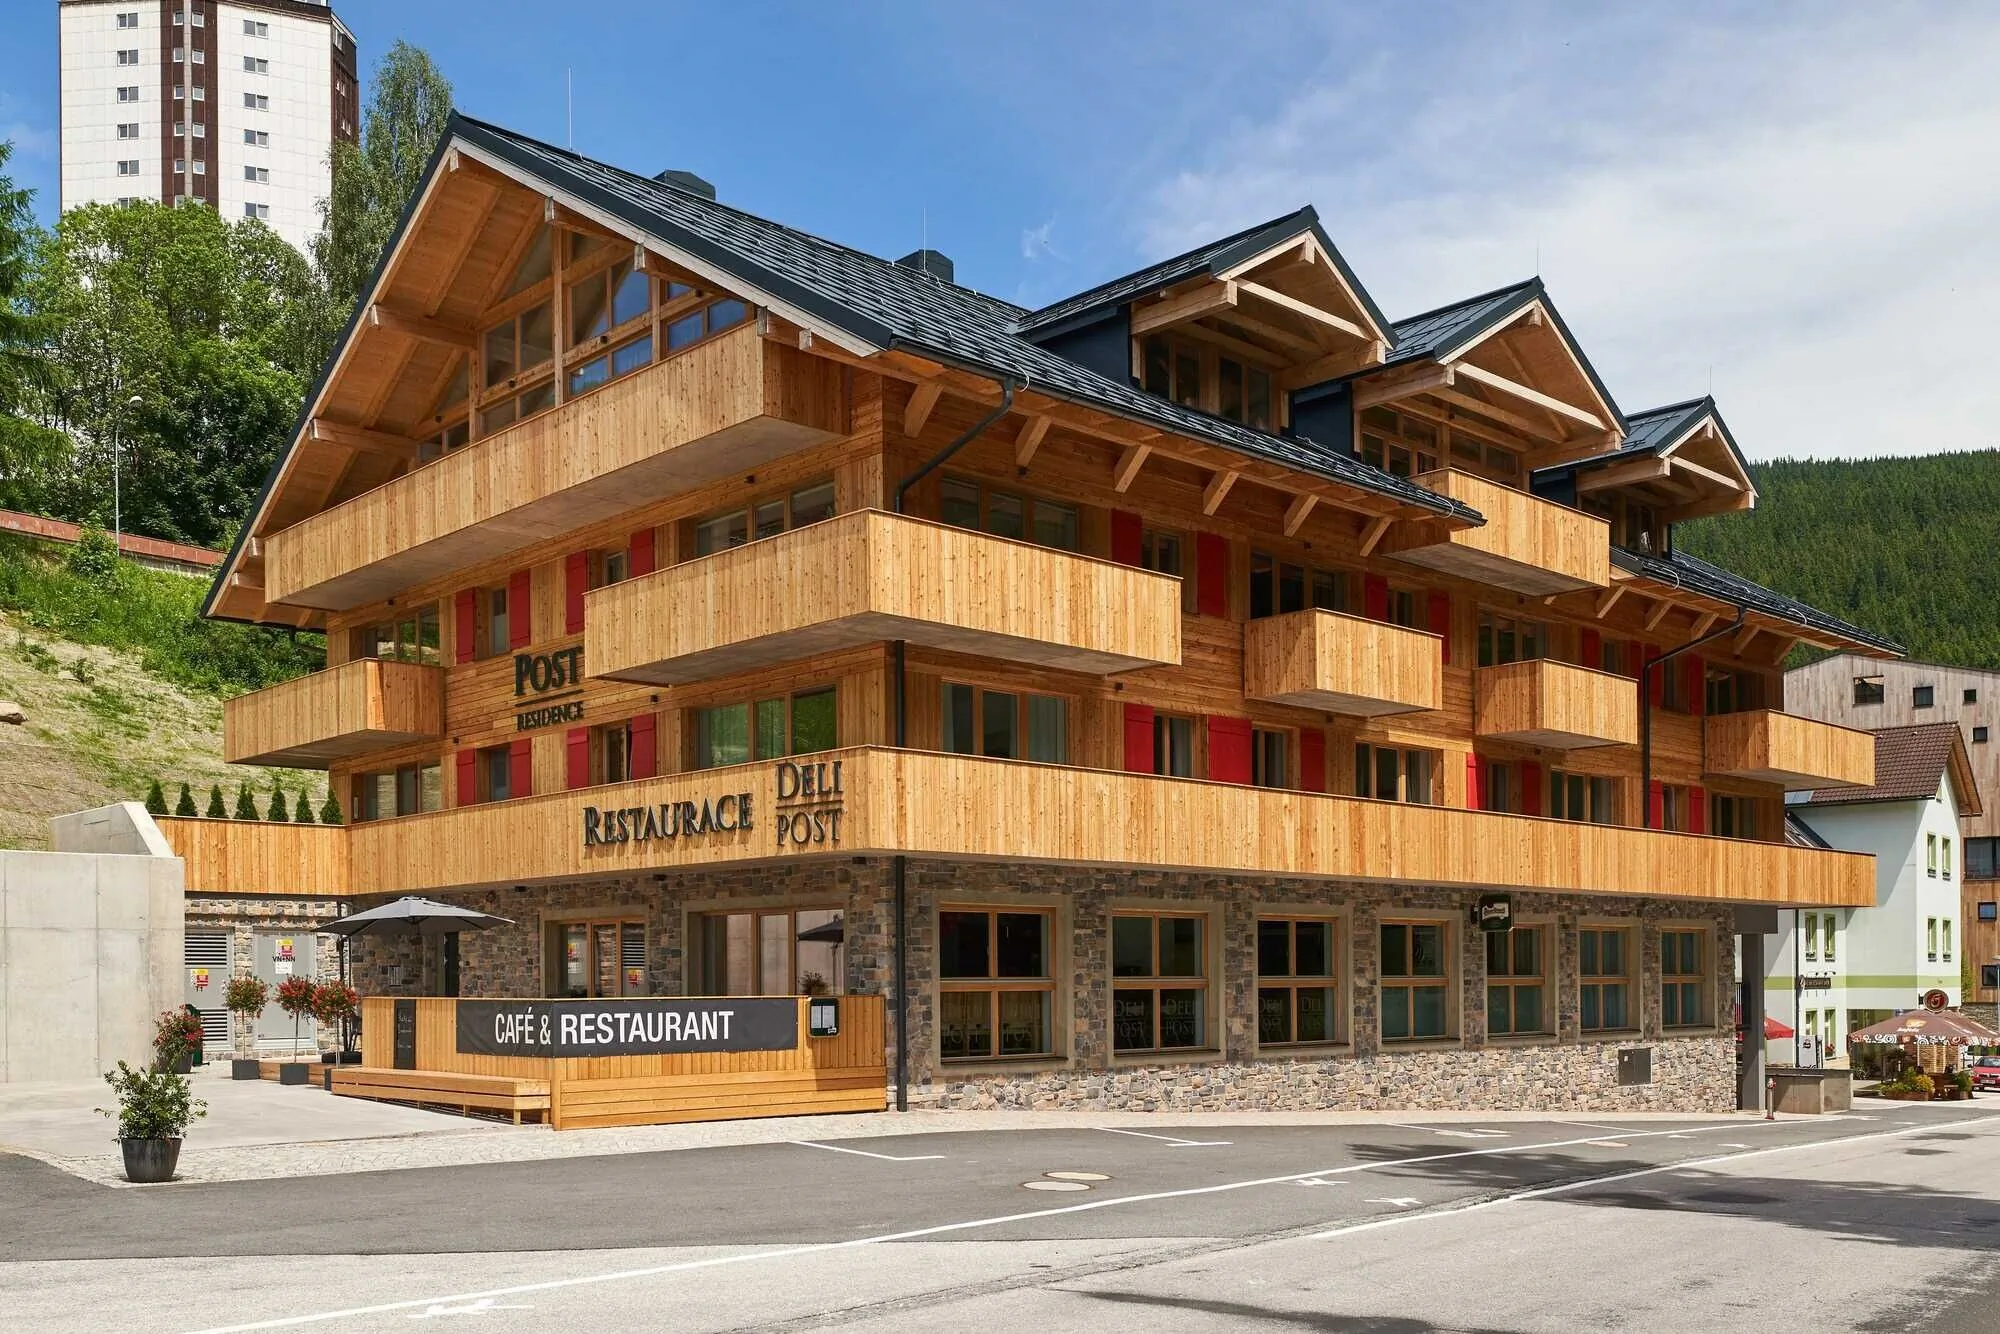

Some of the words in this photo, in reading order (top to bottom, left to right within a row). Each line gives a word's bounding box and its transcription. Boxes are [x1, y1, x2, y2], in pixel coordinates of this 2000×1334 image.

[513, 645, 584, 696] POST
[517, 701, 584, 731] RESIDENCE
[776, 761, 843, 800] DELI
[583, 793, 753, 846] RESTAURACE
[776, 808, 843, 846] POST
[495, 1007, 534, 1044] CAFÉ
[539, 1014, 551, 1044] &
[560, 1011, 734, 1044] RESTAURANT
